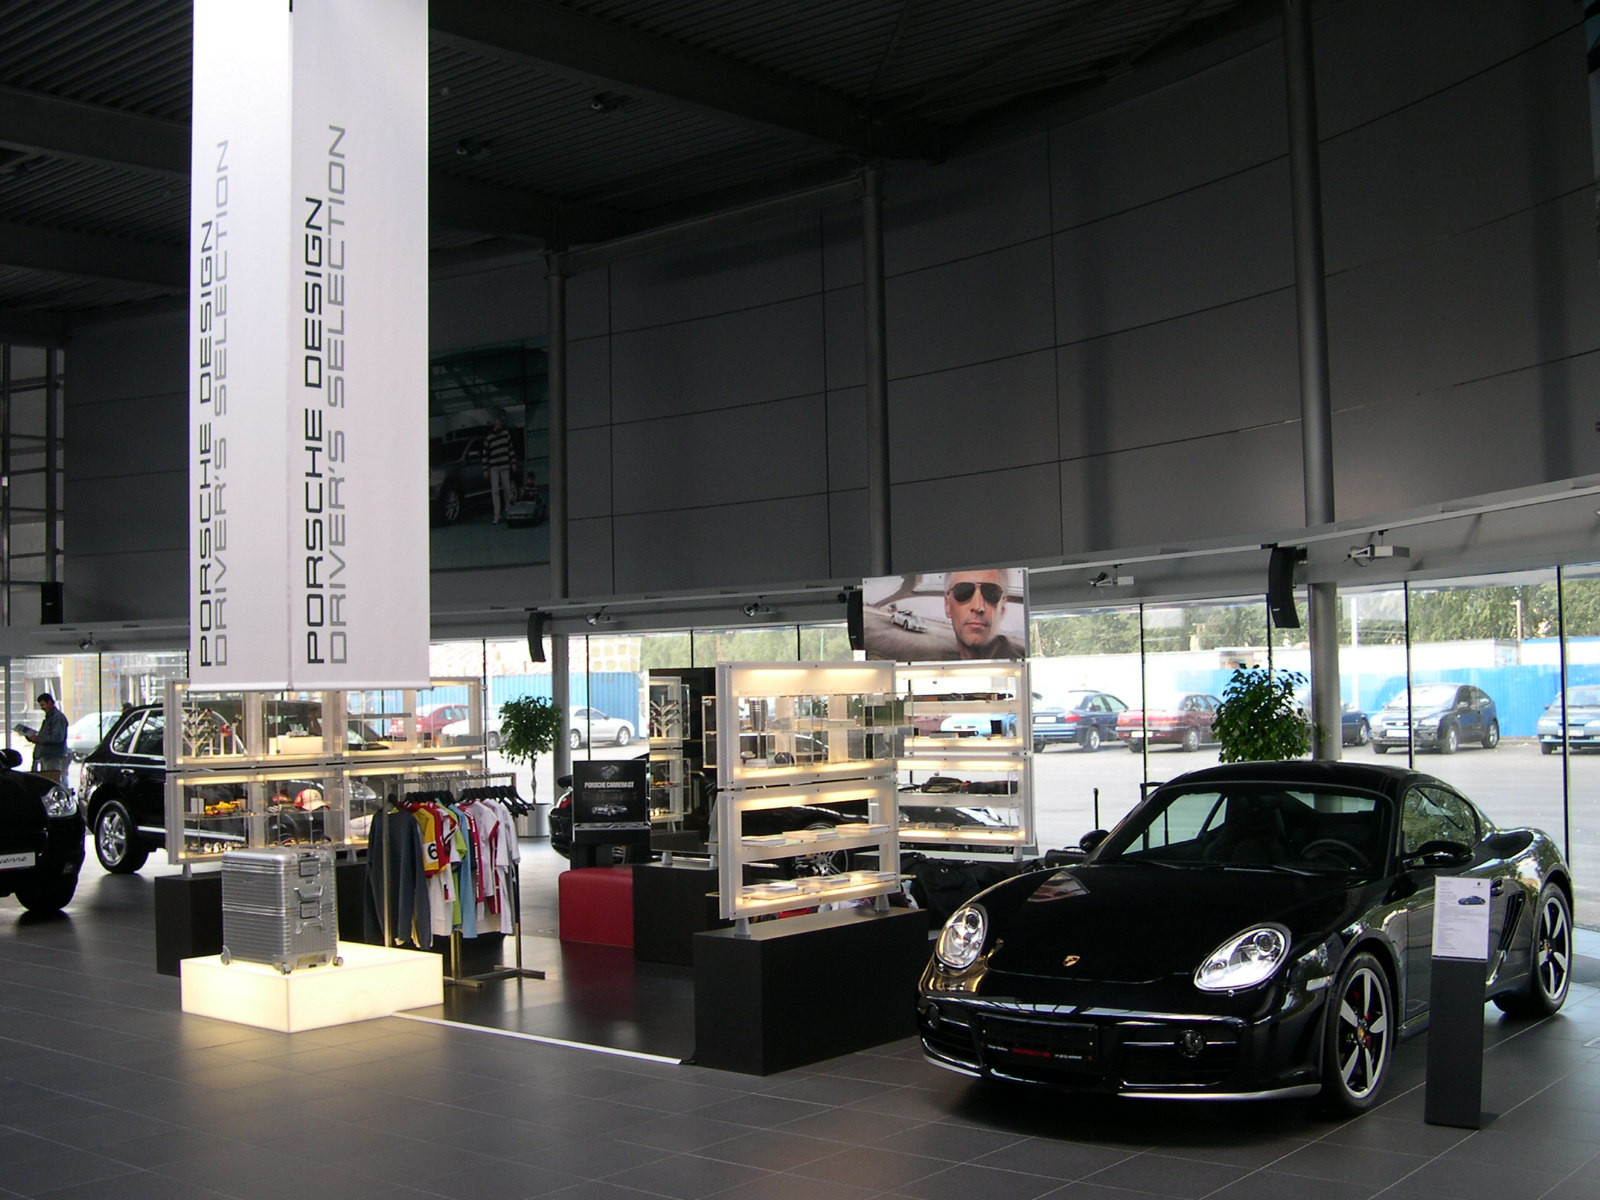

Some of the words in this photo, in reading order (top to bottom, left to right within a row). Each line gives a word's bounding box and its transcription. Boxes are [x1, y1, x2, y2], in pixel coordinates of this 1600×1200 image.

[200, 220, 213, 404] DESIGN
[214, 140, 229, 417] SELECTION
[304, 196, 323, 389] DESIGN
[327, 125, 346, 408] SELECTION
[199, 422, 212, 667] PORSCHE
[214, 437, 228, 667] DRIVER'S
[304, 408, 325, 664] PORSCHE
[327, 430, 347, 664] DRIVER'S
[427, 843, 438, 860] 6
